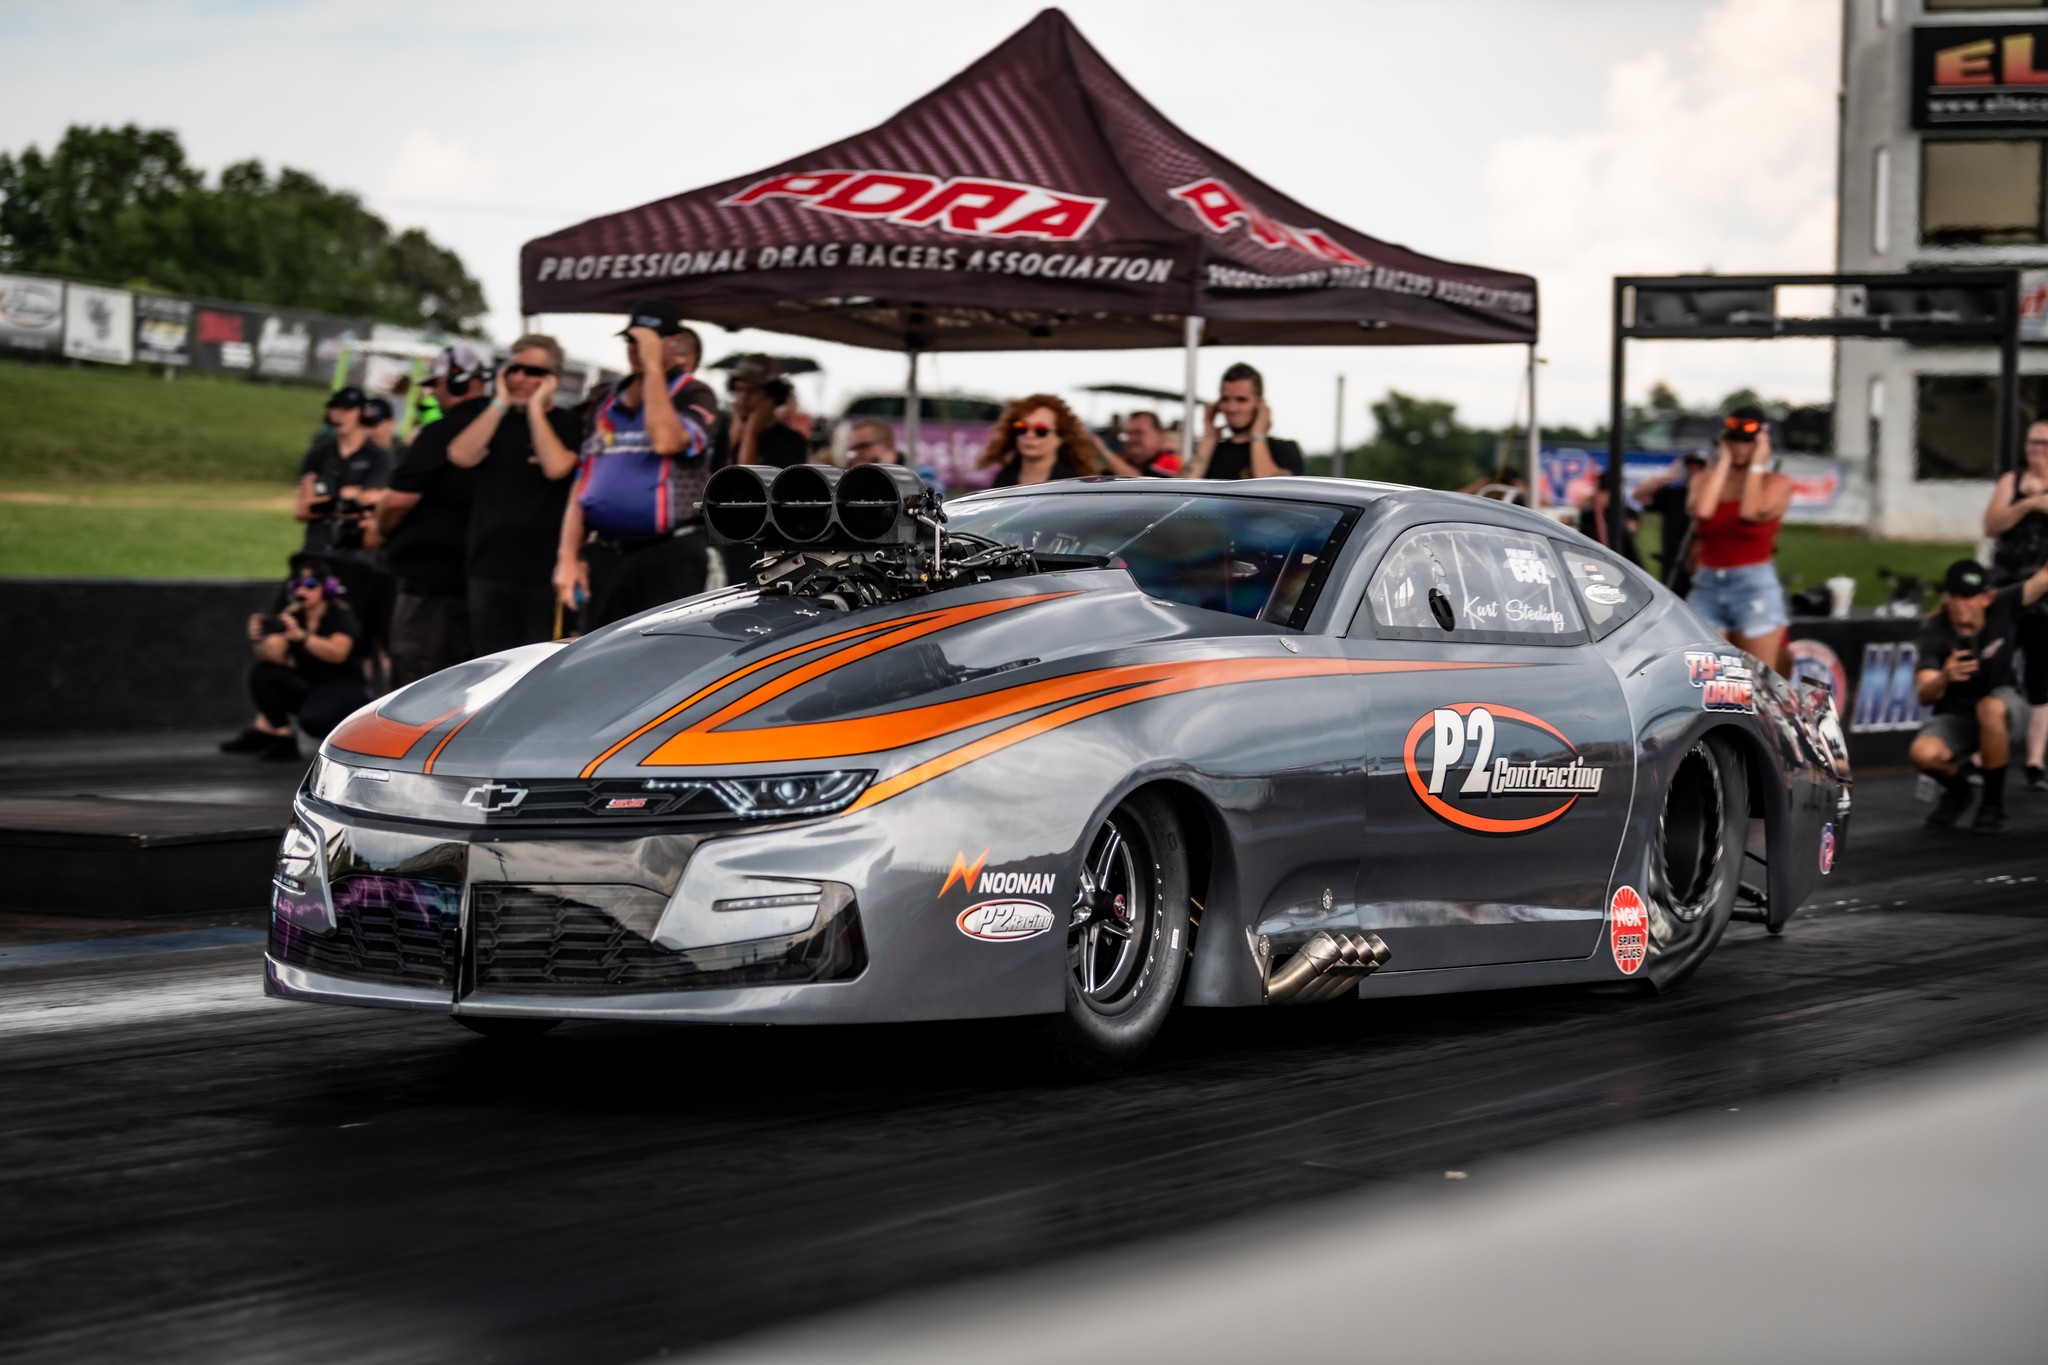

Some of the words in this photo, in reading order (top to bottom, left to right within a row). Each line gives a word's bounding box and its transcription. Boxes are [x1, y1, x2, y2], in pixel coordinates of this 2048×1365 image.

[716, 169, 1107, 241] PDRA
[537, 249, 747, 281] PROFESSIONAL
[757, 244, 842, 270] DRAG
[847, 243, 958, 270] RACERS
[964, 250, 1174, 283] ASSOCIATION
[1463, 596, 1499, 623] Kurt
[1505, 599, 1565, 631] Steding
[1428, 706, 1495, 795] P2
[1491, 756, 1604, 793] Contracting
[978, 872, 1056, 894] NOONAN
[973, 904, 1015, 933] P2
[1007, 914, 1053, 932] Racing
[1615, 906, 1643, 928] NGK
[1618, 947, 1642, 959] PLUGS
